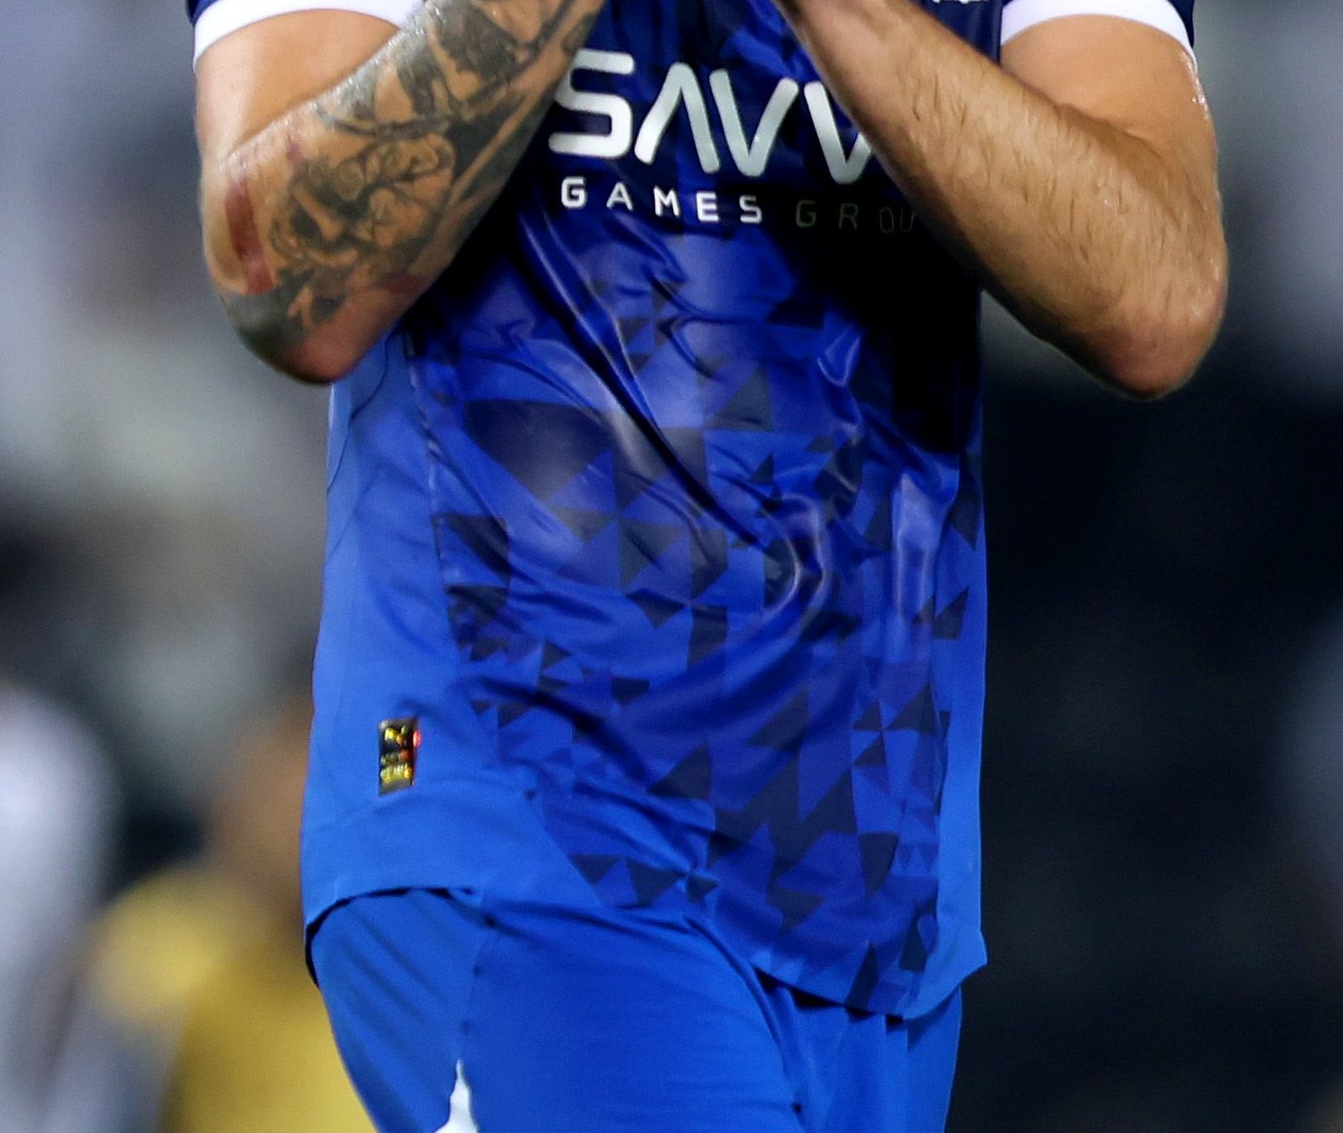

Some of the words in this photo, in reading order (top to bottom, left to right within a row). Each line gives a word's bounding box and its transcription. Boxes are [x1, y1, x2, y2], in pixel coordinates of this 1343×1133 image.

[548, 47, 875, 185] SAVV
[560, 175, 763, 225] GAMES
[795, 198, 916, 235] GROU
